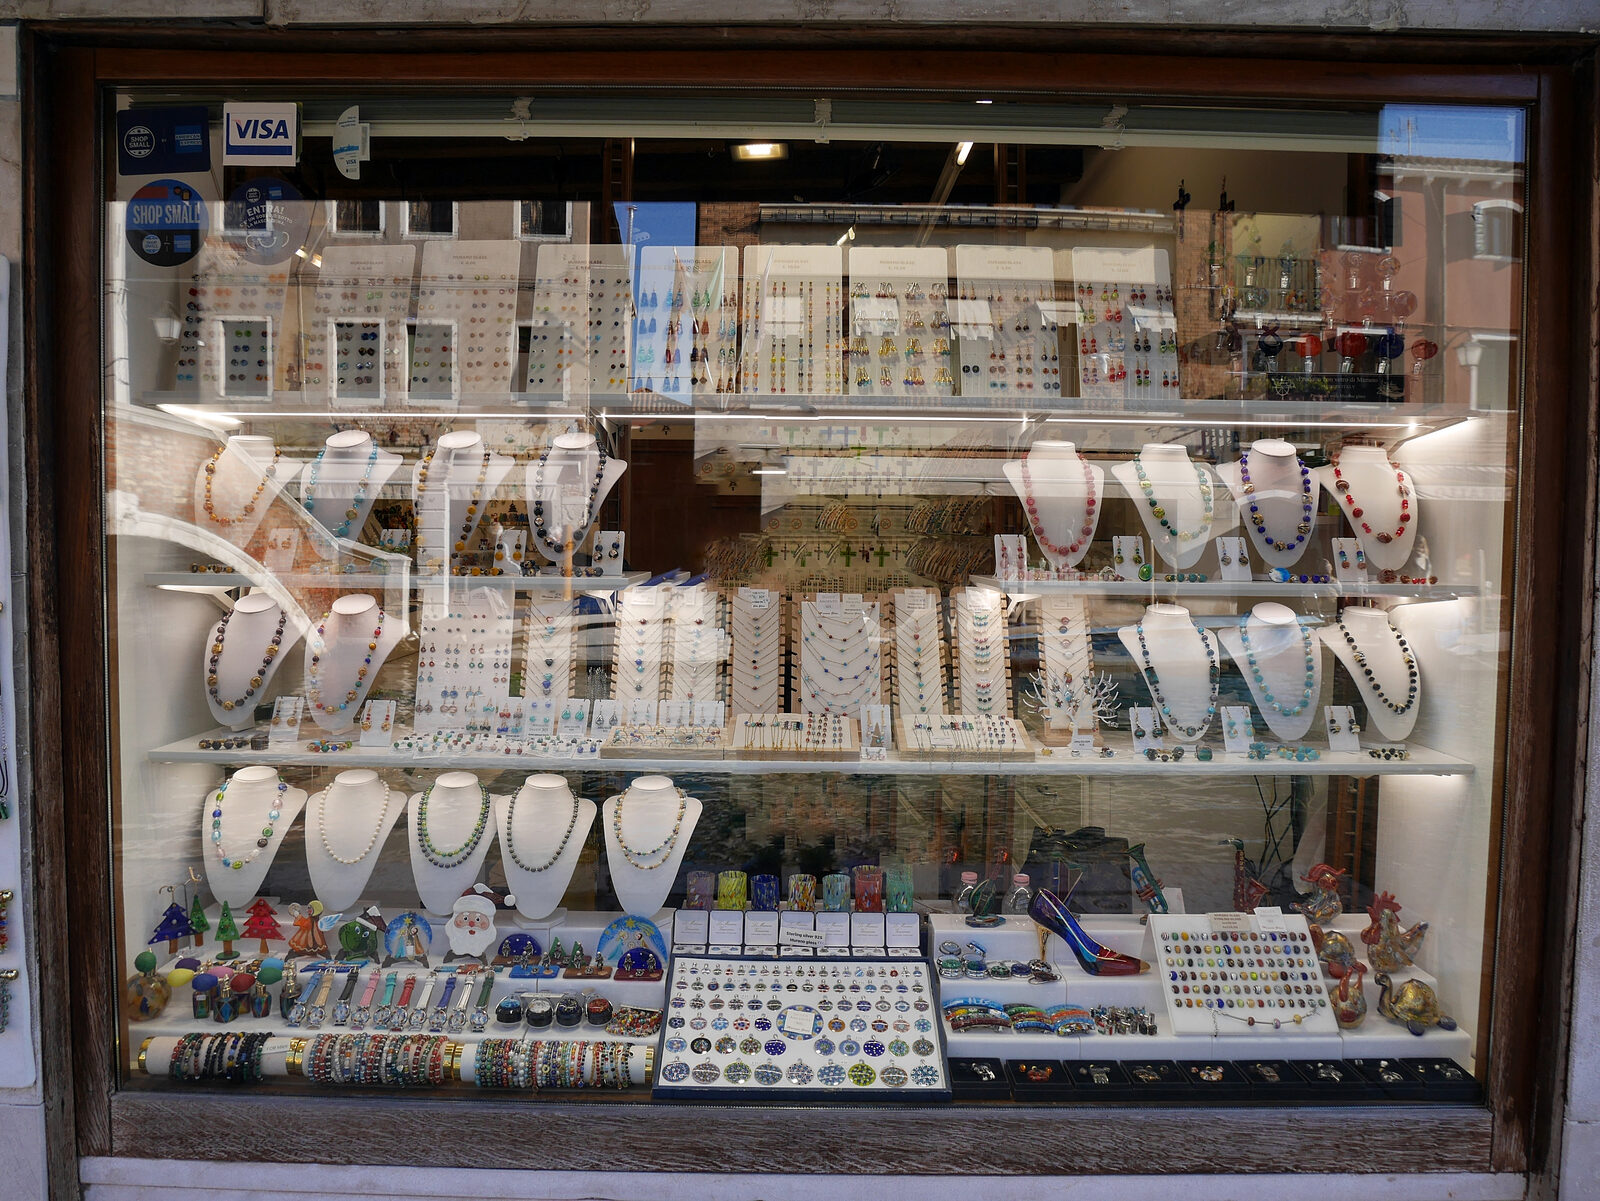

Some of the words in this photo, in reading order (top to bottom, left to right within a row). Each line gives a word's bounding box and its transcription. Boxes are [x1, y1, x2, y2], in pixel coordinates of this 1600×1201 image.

[235, 119, 290, 139] VISA
[129, 141, 151, 149] SMALL
[130, 135, 149, 143] SHOP
[133, 204, 163, 225] SHOP
[165, 204, 201, 225] SMALL
[246, 204, 285, 217] ENTRA!
